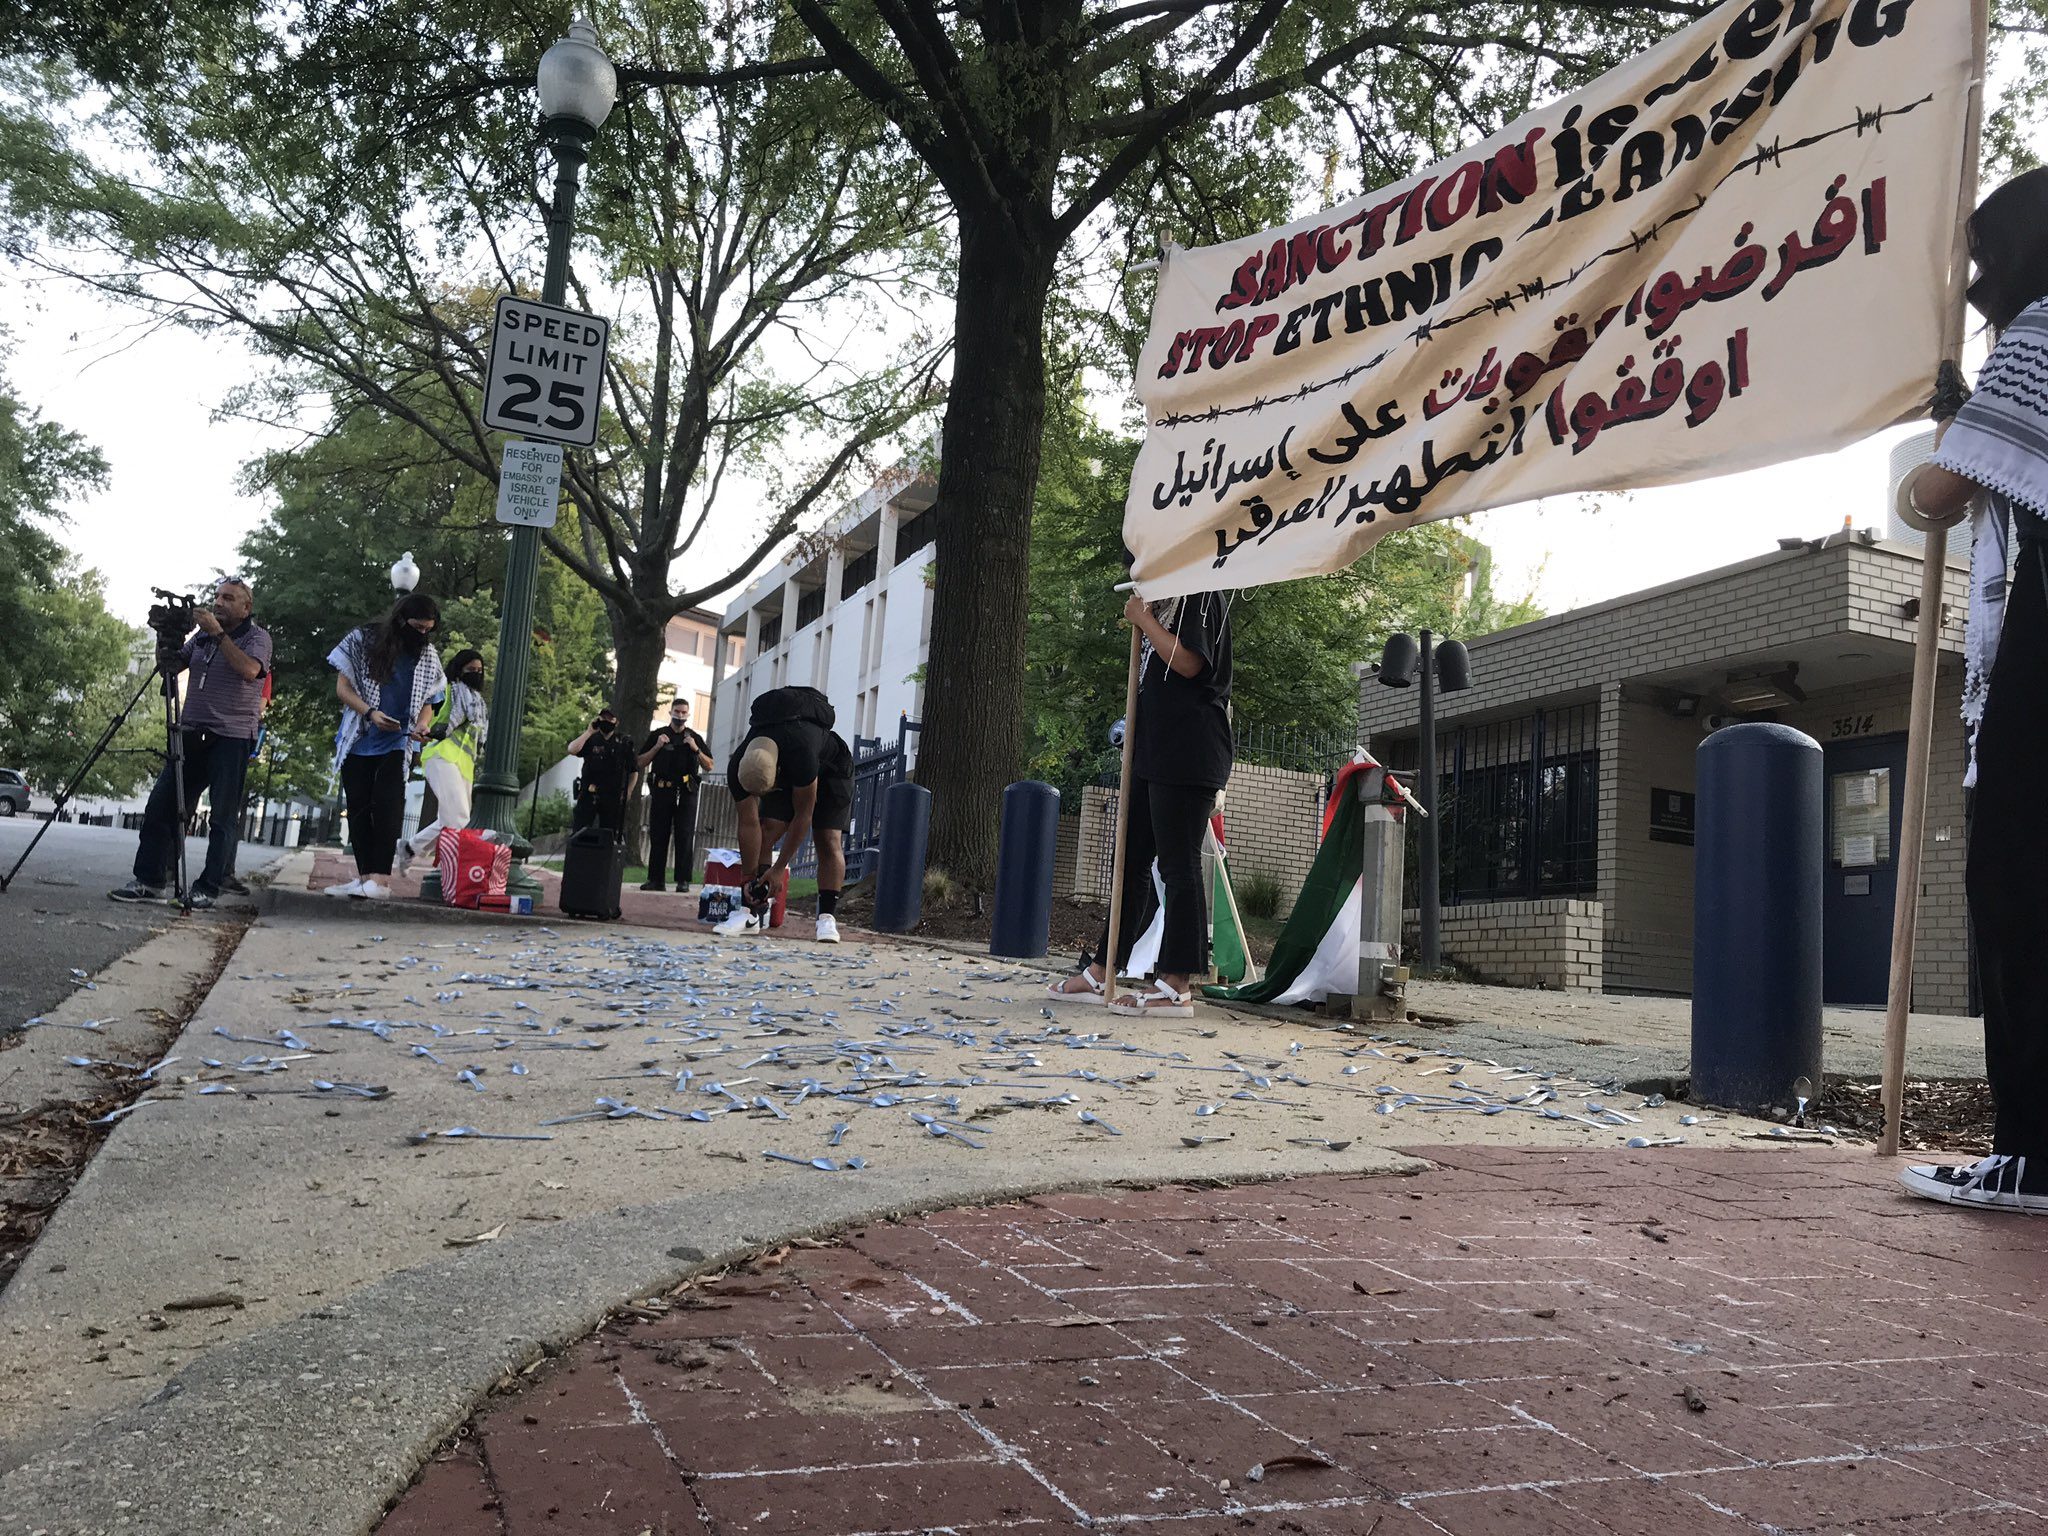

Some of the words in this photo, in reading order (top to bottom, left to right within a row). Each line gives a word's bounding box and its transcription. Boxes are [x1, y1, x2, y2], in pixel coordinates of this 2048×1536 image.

[1216, 126, 1546, 316] SANCTION
[503, 309, 601, 348] SPEED
[1157, 312, 1280, 381] STOP
[508, 340, 588, 375] LIMIT
[497, 373, 585, 431] 25
[1307, 399, 1406, 465] على
[505, 448, 560, 464] RESERVED
[521, 462, 543, 473] FOR
[503, 471, 543, 483] EMBASSY
[546, 476, 558, 485] OF
[511, 483, 547, 496] ISRAEL
[507, 494, 550, 508] VEHICLE
[513, 506, 541, 518] ONLY
[1831, 714, 1874, 738] 3514
[708, 908, 728, 916] PARK
